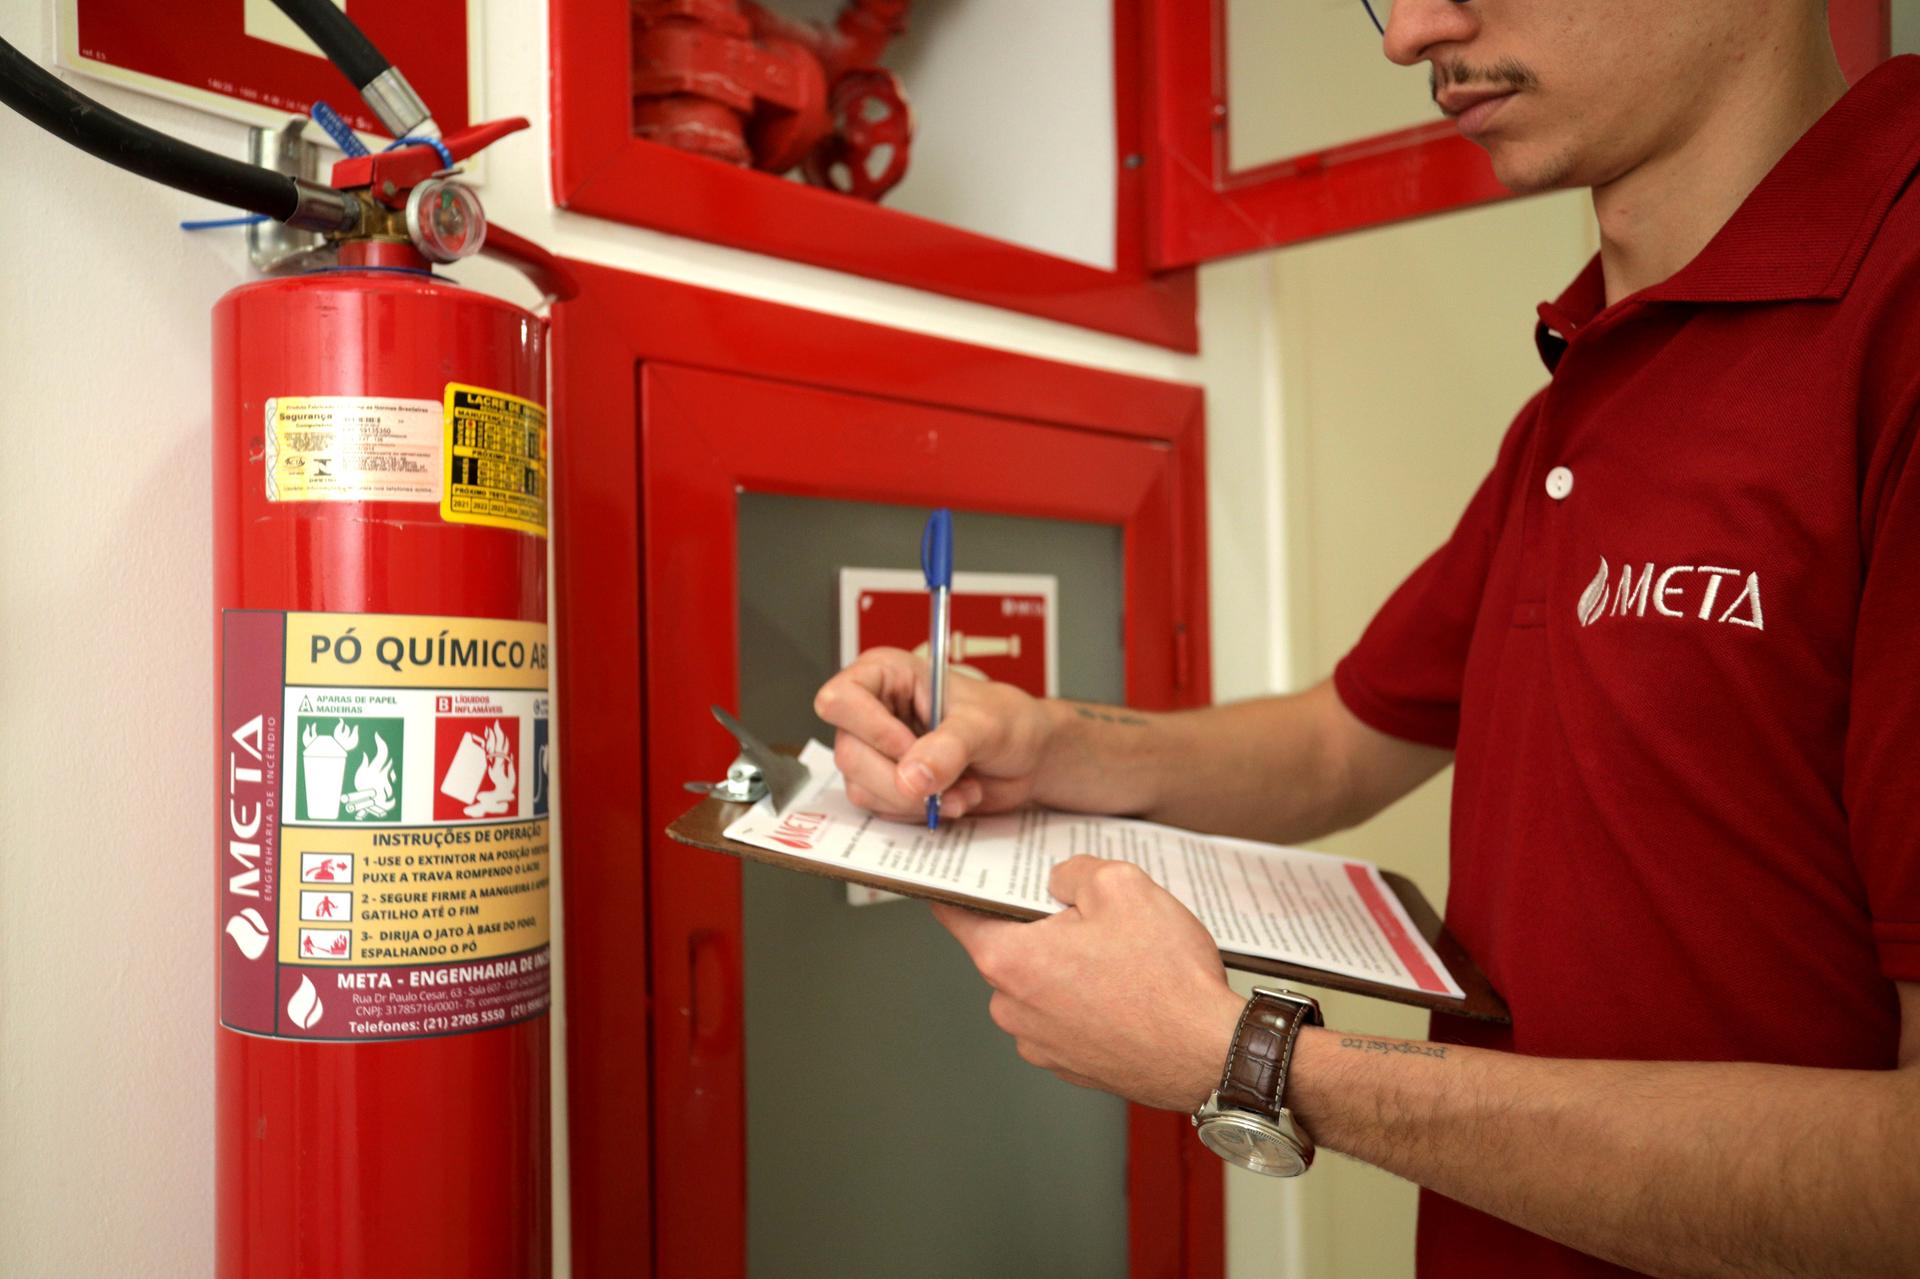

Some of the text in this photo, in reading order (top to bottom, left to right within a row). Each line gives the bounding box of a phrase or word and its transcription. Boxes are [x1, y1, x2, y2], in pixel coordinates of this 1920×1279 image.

[280, 412, 333, 422] Segurança
[453, 499, 470, 508] 2021
[1609, 562, 1764, 631] META
[310, 627, 548, 672] PÓ QUÍMICO AB
[316, 695, 398, 704] APARAS DE PAPEL
[454, 694, 490, 704] LÍQUIDOS
[316, 706, 363, 714] MADEIRAS
[454, 704, 503, 714] INFLAMÁVEIS
[230, 714, 263, 898] META
[264, 716, 276, 902] ENGENHARIA DE INCÊNDIO
[372, 823, 542, 848] INSTRUÇÕES DE OPERAÇÃO
[405, 856, 415, 866] O
[418, 853, 476, 866] EXTINTOR
[479, 850, 495, 862] NA
[496, 846, 530, 861] POSIÇÃO
[362, 872, 396, 883] PUXE
[399, 872, 409, 883] A
[412, 870, 453, 882] TRAVA
[456, 864, 512, 880] ROMPENDO
[514, 865, 521, 874] O
[361, 894, 369, 904] 2
[380, 892, 428, 904] SEGURE
[432, 889, 466, 902] FIRME
[469, 888, 478, 898] A
[480, 880, 531, 898] MANGUEIRA
[361, 904, 480, 920] GATILHO ATÉ O FIM
[379, 930, 420, 943] DIRIJA
[423, 929, 433, 940] O
[434, 926, 464, 940] JATO
[466, 924, 474, 936] À
[477, 924, 501, 935] BASE
[503, 920, 516, 931] DO
[360, 942, 478, 958] ESPALHANDO O PÓ
[337, 972, 392, 990] META
[409, 960, 518, 987] ENGENHARIA
[520, 955, 533, 972] DE
[352, 993, 372, 1004] Rua
[374, 992, 388, 1003] Dr
[389, 991, 418, 1003] Paulo
[419, 990, 449, 1001] Cesar,
[450, 988, 462, 998] 63
[468, 986, 486, 996] Sala
[348, 1020, 420, 1033] Telefones:
[423, 1016, 448, 1032] (21)
[450, 1013, 478, 1028] 2705
[480, 1008, 506, 1022] 5550
[355, 1005, 383, 1017] CNPJ:
